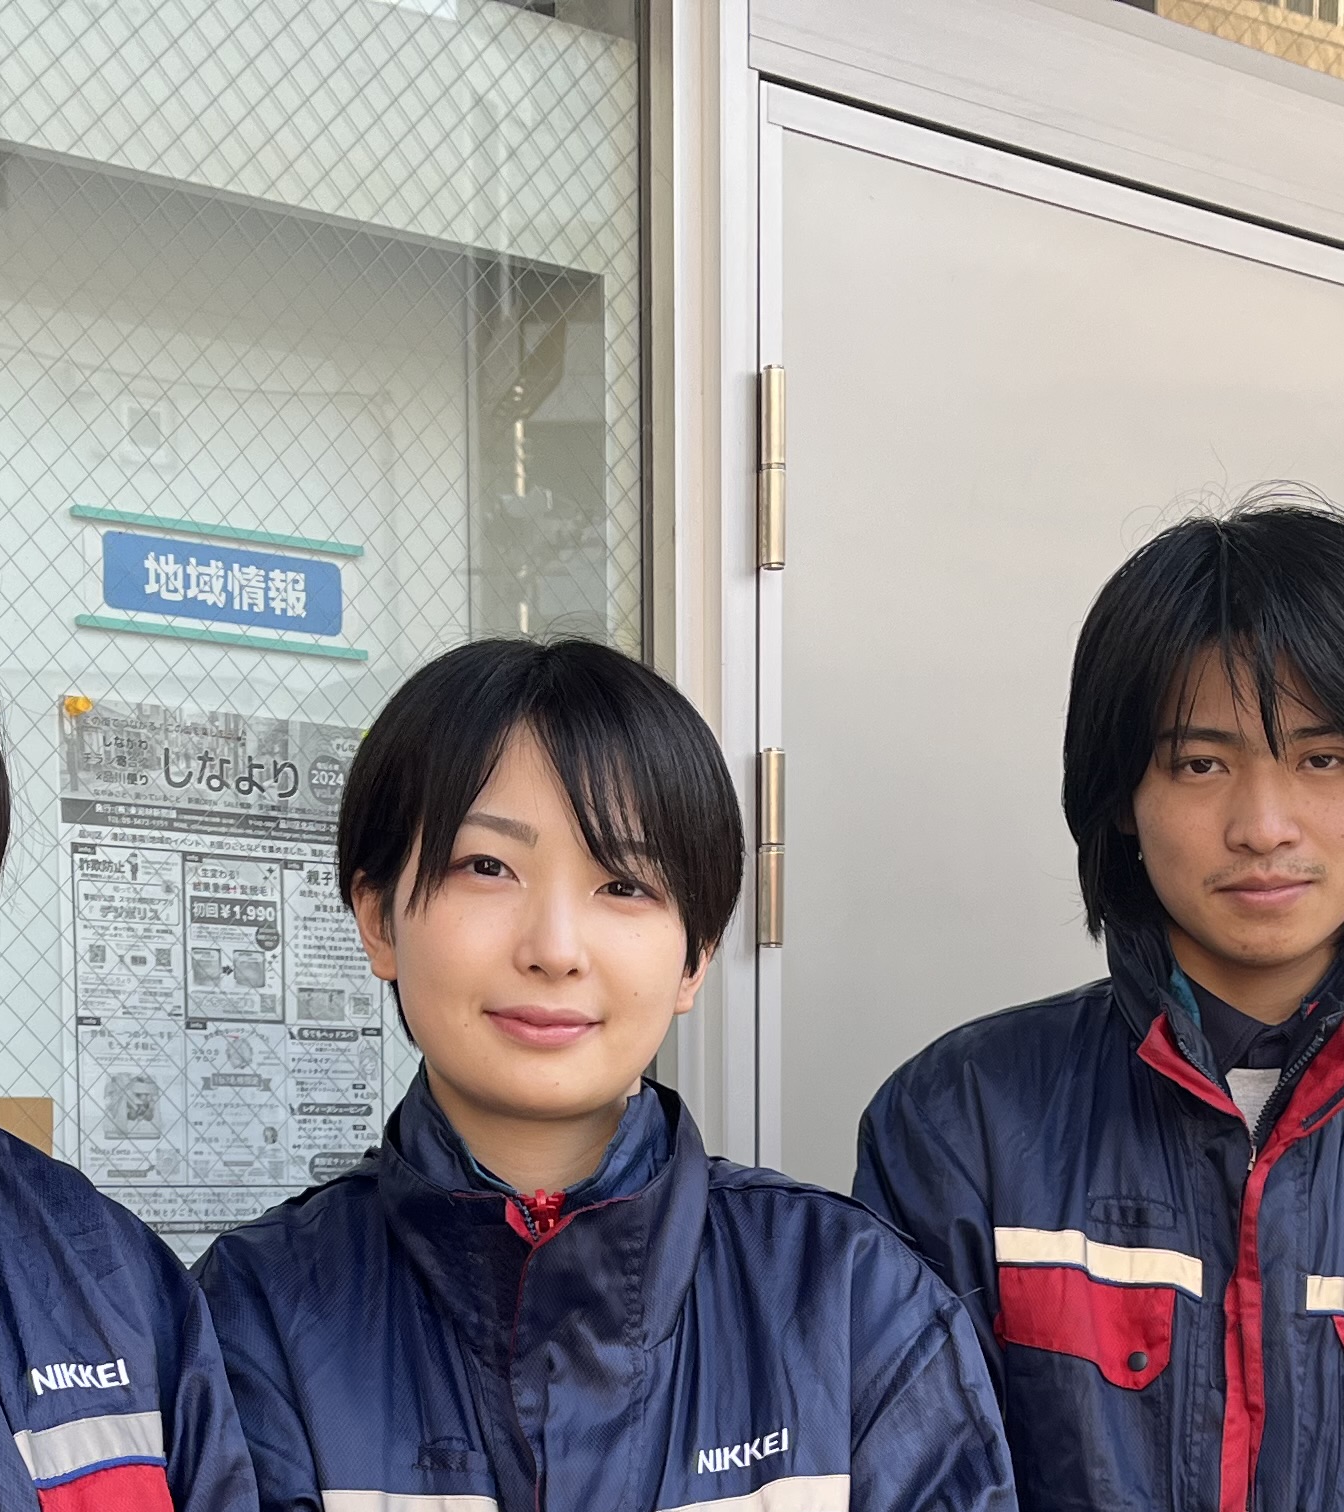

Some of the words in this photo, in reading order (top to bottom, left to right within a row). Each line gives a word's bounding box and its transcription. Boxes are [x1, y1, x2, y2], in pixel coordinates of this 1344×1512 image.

[144, 552, 307, 618] 地域情報
[163, 747, 299, 799] しなより
[30, 1358, 130, 1396] NIKKEI
[697, 1427, 789, 1475] NIKKEI
